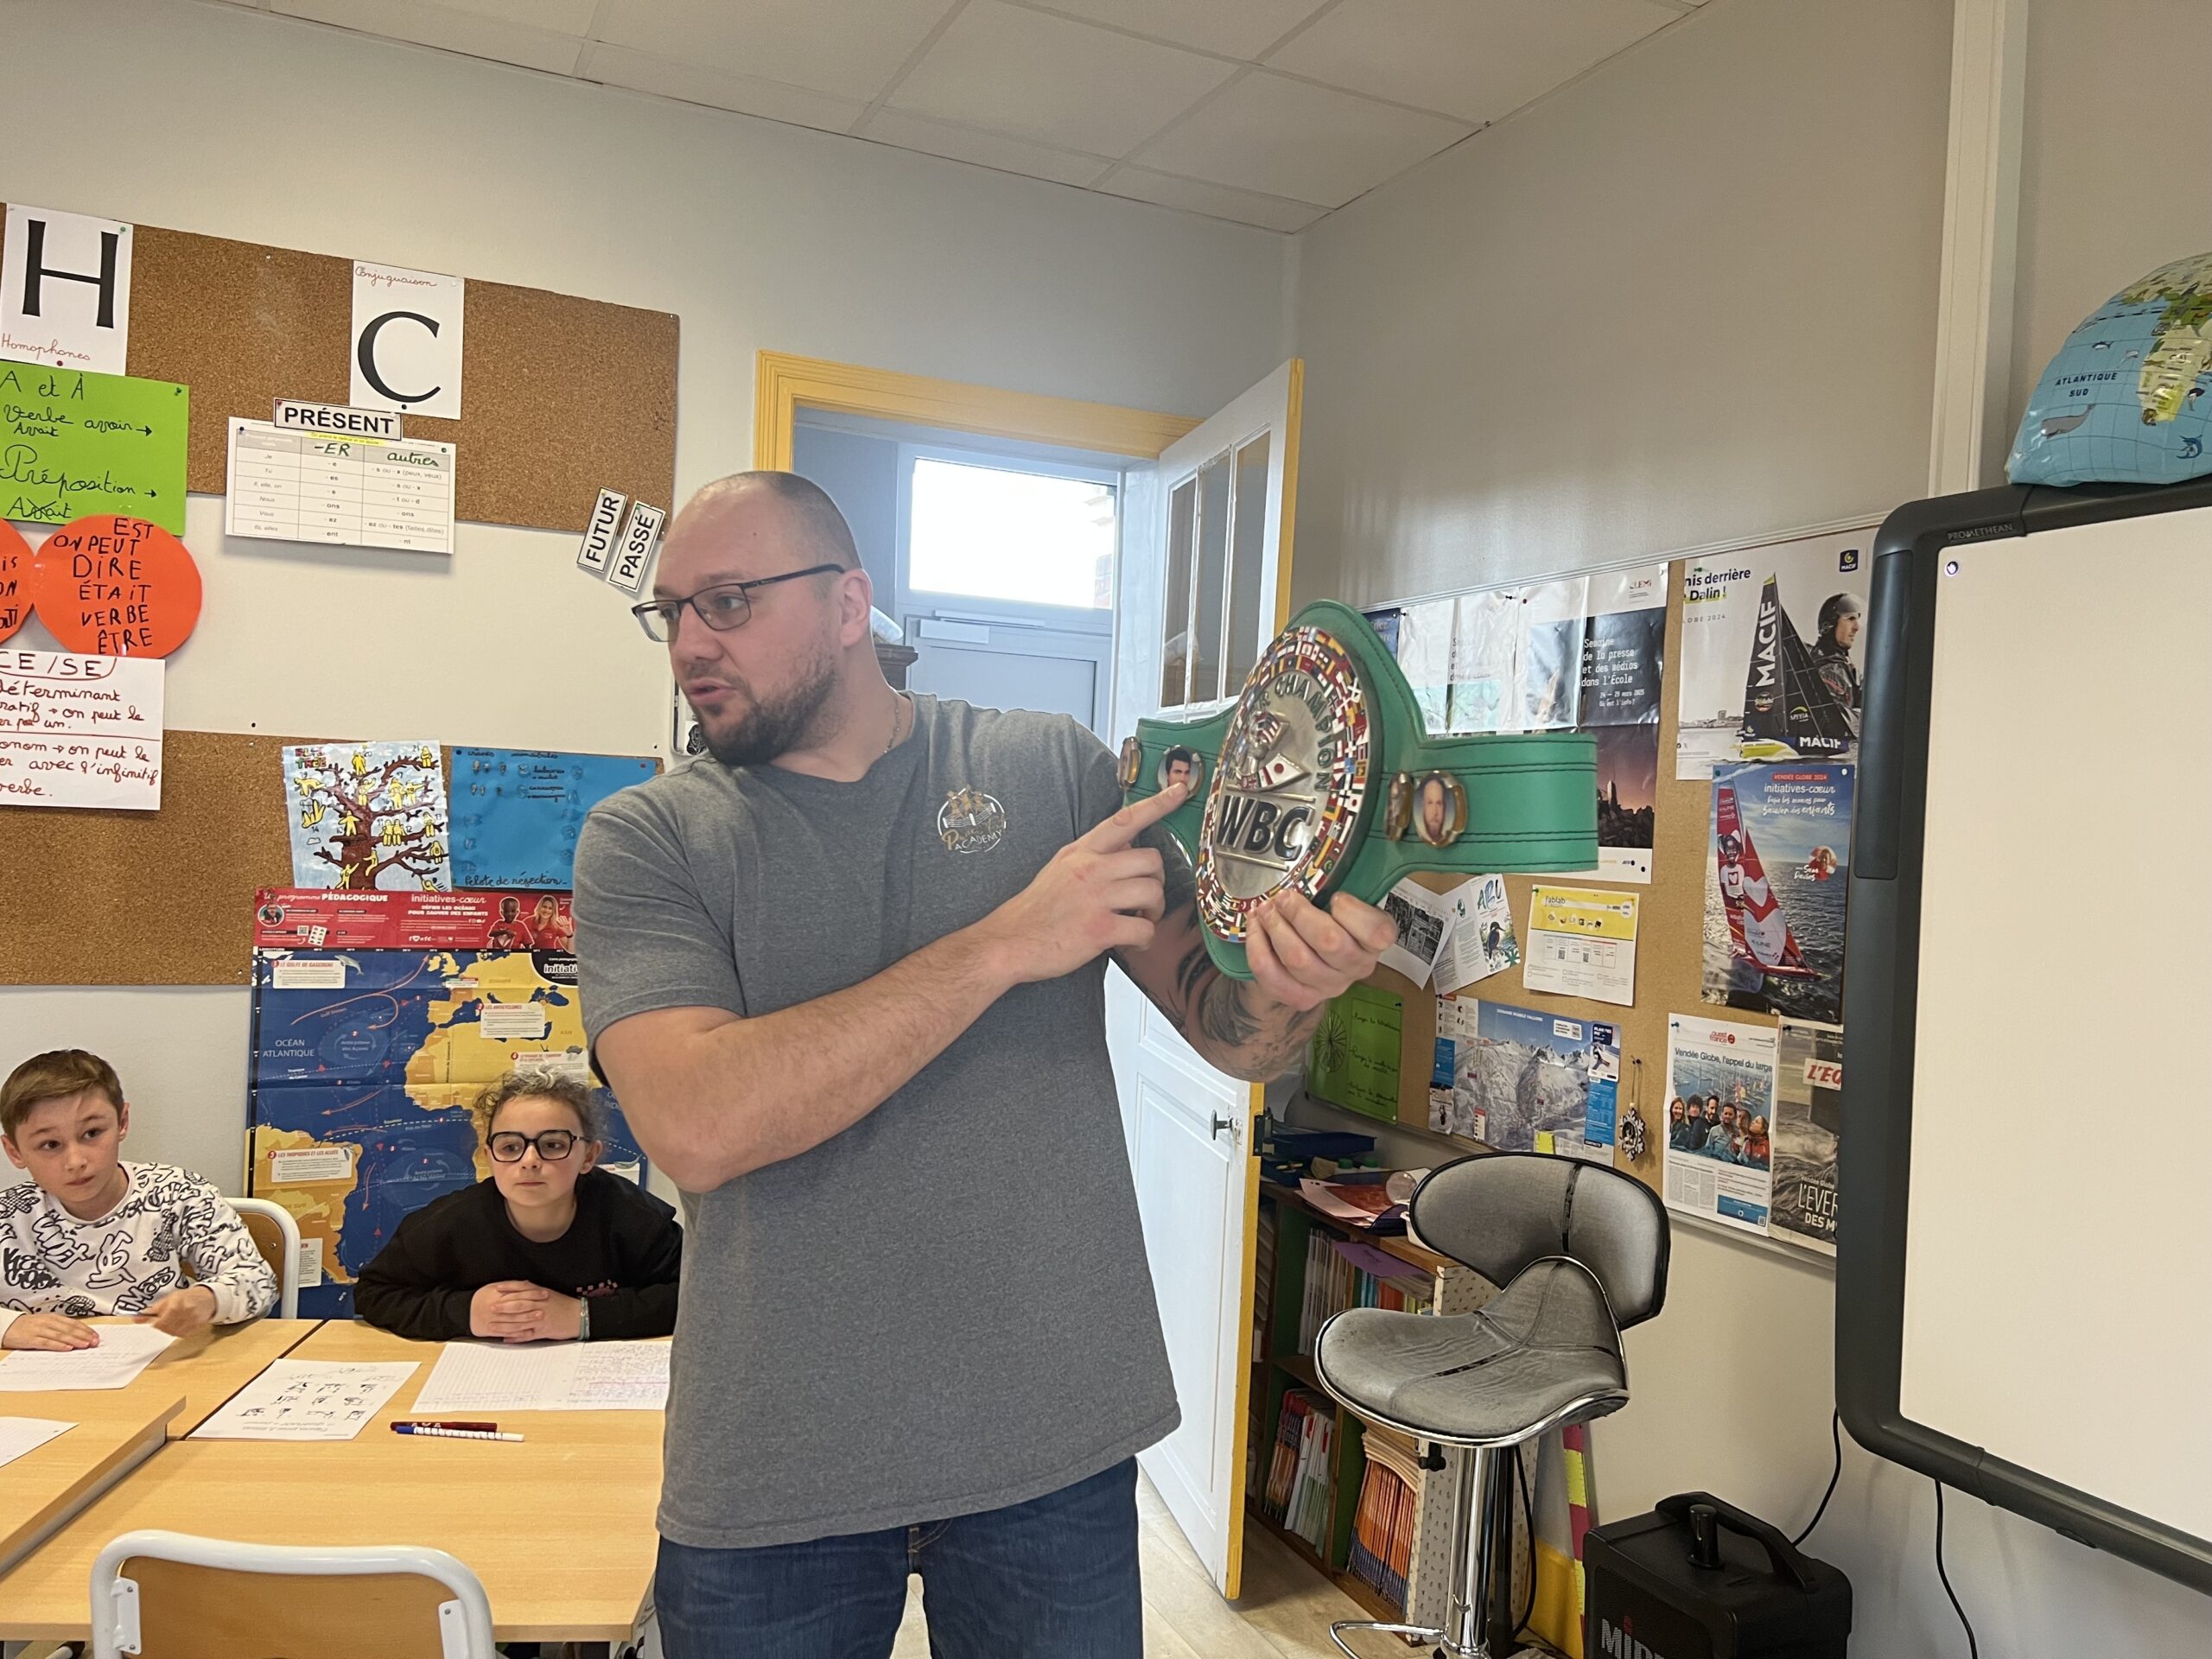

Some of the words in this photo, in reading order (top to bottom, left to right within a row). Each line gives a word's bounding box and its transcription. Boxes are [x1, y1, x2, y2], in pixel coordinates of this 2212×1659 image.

[22, 219, 119, 328] H
[2, 333, 91, 360] Homophones
[0, 371, 21, 392] A
[39, 375, 60, 397] et
[2055, 372, 2117, 385] ATLANTIQUE
[85, 420, 132, 432] avoir
[285, 407, 394, 434] PRÉSENT
[387, 452, 439, 467] autres
[114, 517, 154, 539] EST
[586, 495, 620, 563] FUTUR
[1948, 524, 2013, 540] PROMETHEAN
[54, 535, 82, 551] ON
[88, 535, 140, 556] PEUT
[620, 512, 654, 579] PASSÉ
[1705, 568, 1751, 584] derrière
[82, 604, 149, 626] VERBE
[98, 627, 152, 654] ÊTRE
[1584, 636, 1614, 648] Semaine
[1756, 601, 1777, 687] MACIF
[1583, 652, 1592, 661] de
[1596, 651, 1605, 660] la
[1608, 650, 1635, 662] presse
[1583, 665, 1592, 674] et
[1595, 664, 1608, 673] des
[1611, 661, 1638, 671] médias
[1581, 677, 1599, 687] dans
[1603, 672, 1633, 685] l'École
[62, 709, 85, 718] on
[92, 709, 122, 723] peut
[129, 705, 145, 721] le
[1274, 675, 1334, 791] CHAMPION
[68, 746, 89, 755] on
[96, 746, 126, 760] peut
[136, 745, 149, 762] le
[29, 760, 74, 771] avec
[1217, 795, 1315, 861] WBC
[955, 830, 1001, 850] ACADEMY
[496, 875, 510, 886] de
[321, 892, 388, 902] PÉDAGOGIQUE
[276, 1035, 305, 1046] OCÉAN
[263, 1048, 315, 1058] ATLANTIQUE
[1675, 1047, 1699, 1059] Vendée
[1722, 1054, 1744, 1067] l'appel
[1745, 1059, 1754, 1069] du
[1805, 1212, 1825, 1228] DES
